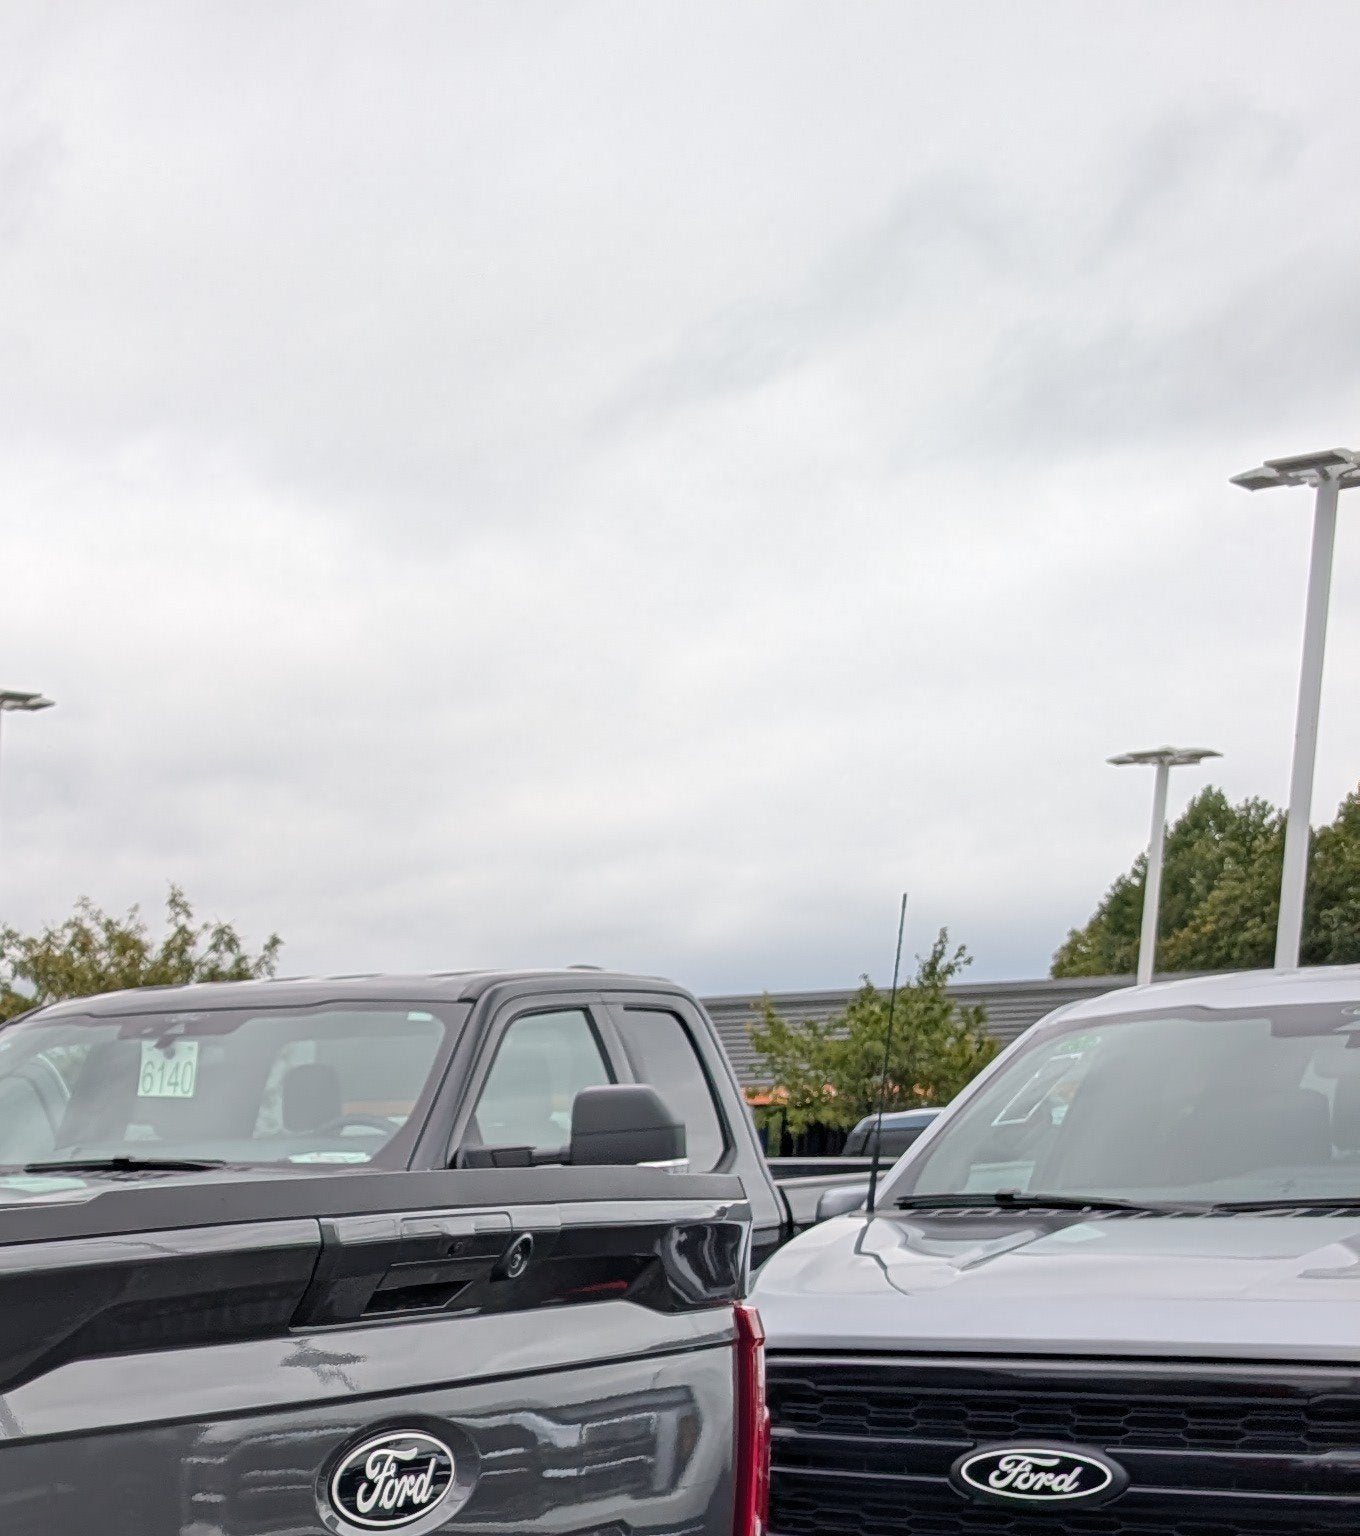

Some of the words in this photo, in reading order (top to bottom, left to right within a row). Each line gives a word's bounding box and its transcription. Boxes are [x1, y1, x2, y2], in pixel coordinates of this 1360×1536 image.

[141, 1061, 194, 1095] 6140
[356, 1446, 437, 1514] Ford
[988, 1454, 1084, 1493] Ford
